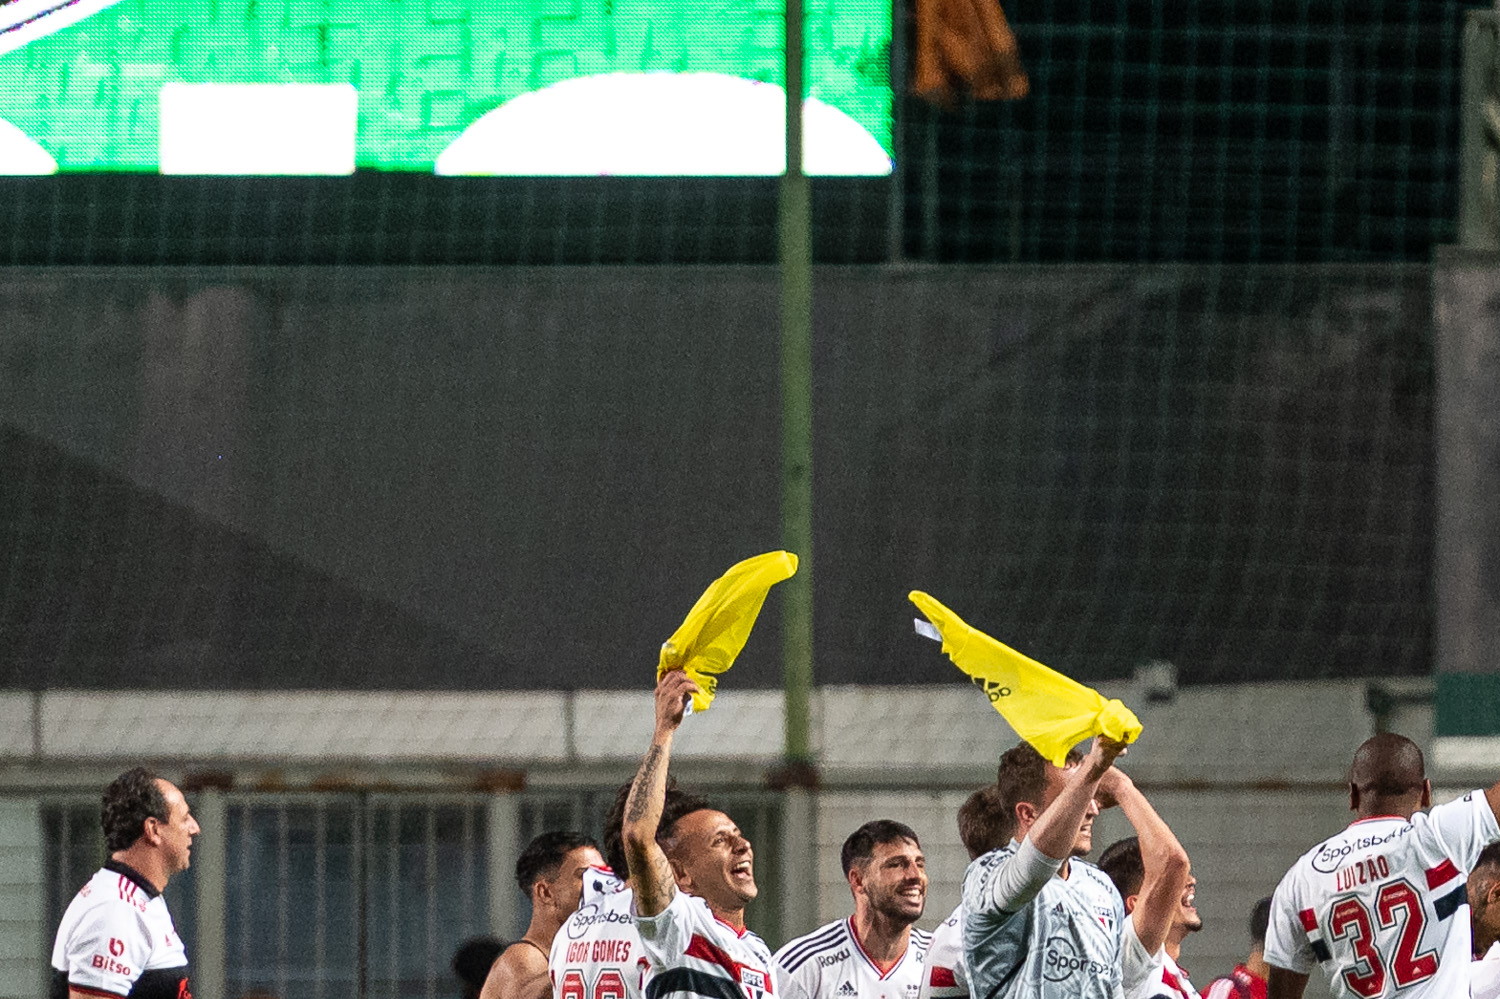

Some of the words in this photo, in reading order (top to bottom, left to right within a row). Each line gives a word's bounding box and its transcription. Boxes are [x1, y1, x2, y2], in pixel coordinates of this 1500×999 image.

[1337, 854, 1390, 892] LUIZÃO
[566, 941, 590, 963] IGOR
[592, 940, 631, 963] GOMES
[818, 948, 851, 968] Roku
[92, 953, 131, 976] Bitso
